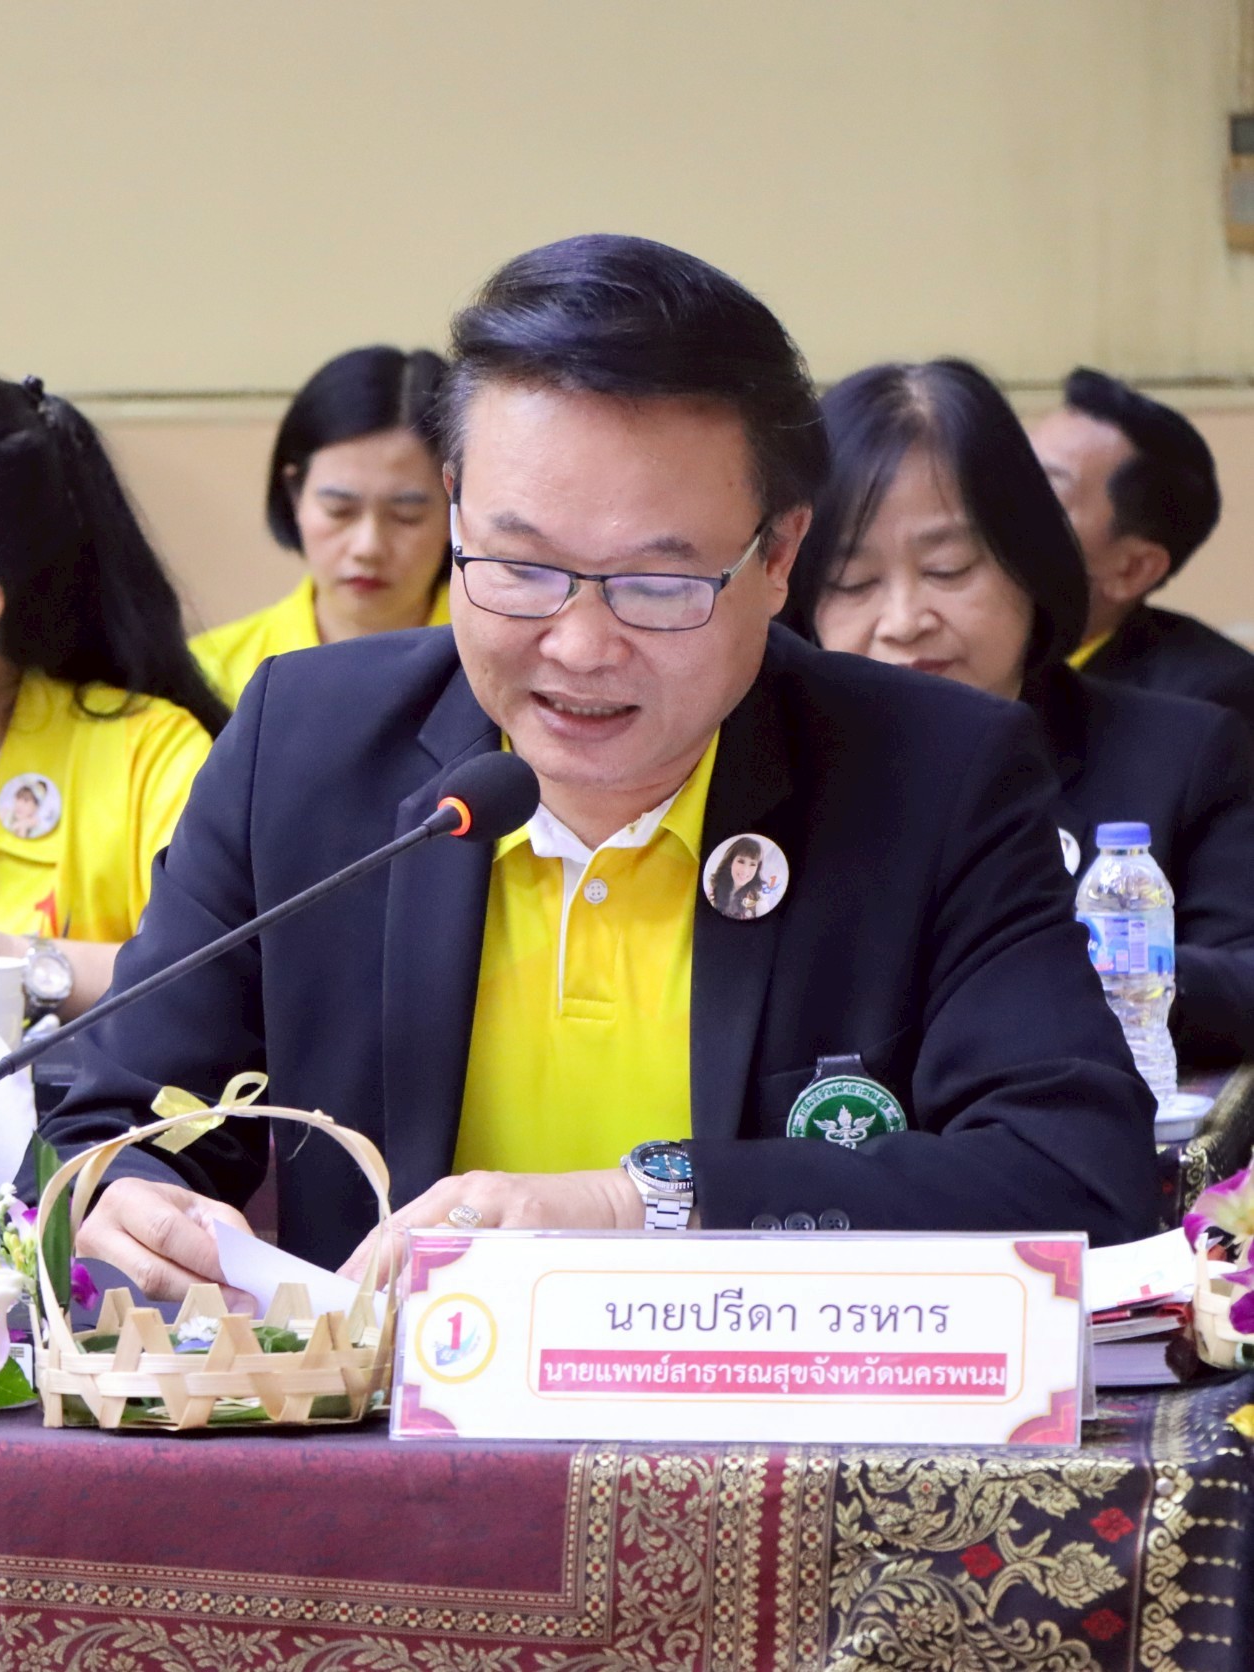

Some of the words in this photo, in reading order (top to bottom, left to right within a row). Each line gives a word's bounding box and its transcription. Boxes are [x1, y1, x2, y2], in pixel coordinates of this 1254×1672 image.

[447, 1311, 463, 1350] 1
[605, 1287, 797, 1333] นายปรีดา
[819, 1303, 950, 1334] วรหาร
[543, 1353, 1006, 1394] นายแพทย์สาธารณสุขจังหวัดนครพนม
